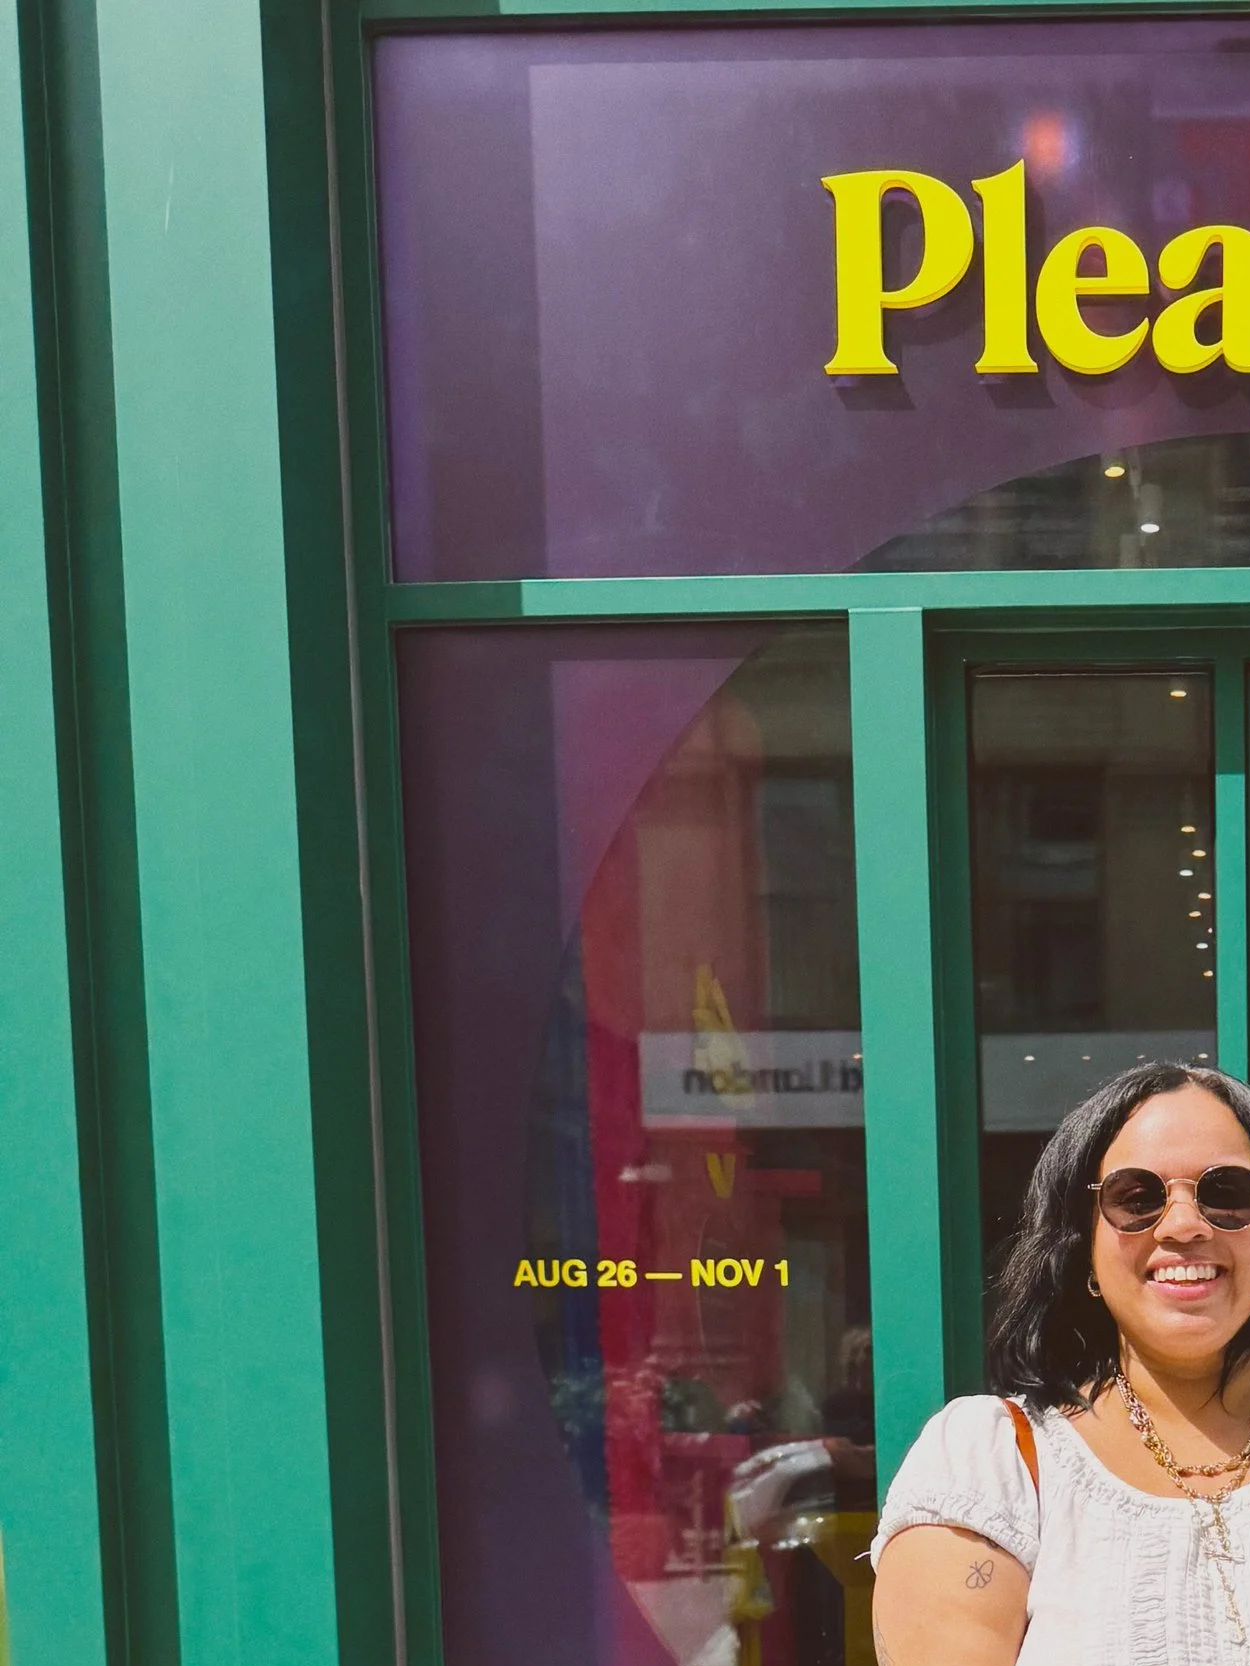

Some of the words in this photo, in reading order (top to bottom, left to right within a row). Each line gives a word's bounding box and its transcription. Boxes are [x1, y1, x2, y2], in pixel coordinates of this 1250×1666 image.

[513, 1259, 588, 1288] AUG
[596, 1259, 638, 1288] 26
[690, 1258, 764, 1288] NOV
[774, 1259, 790, 1287] 1
